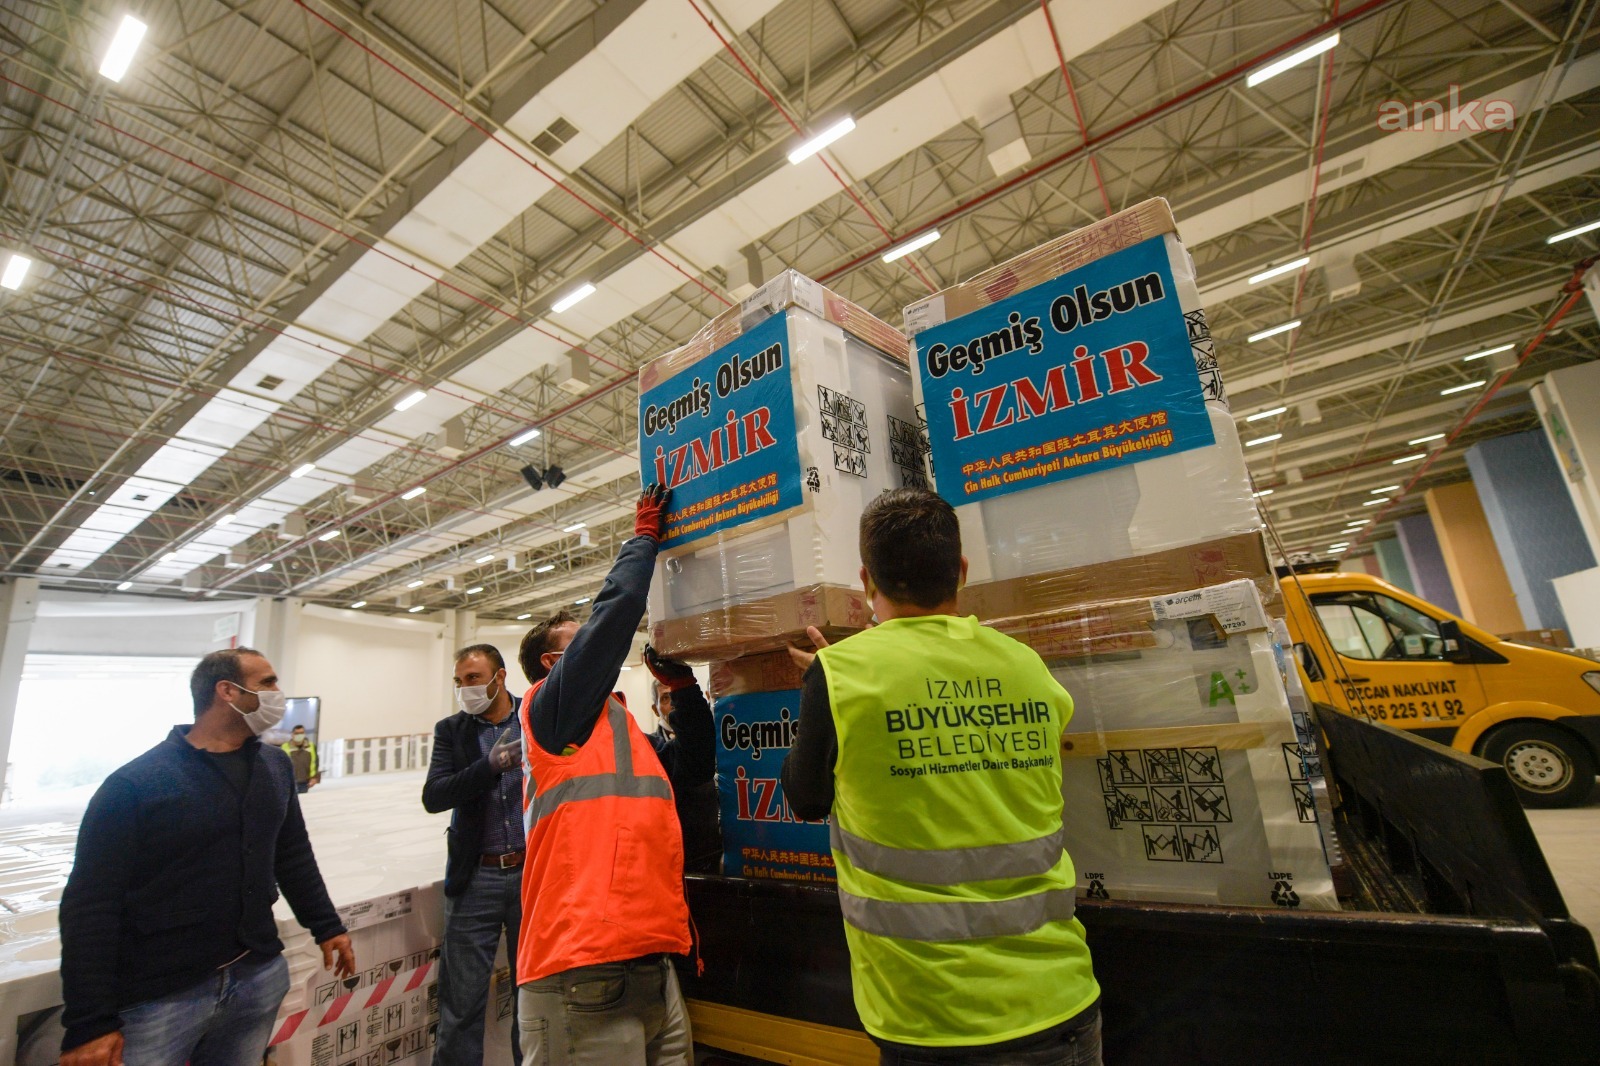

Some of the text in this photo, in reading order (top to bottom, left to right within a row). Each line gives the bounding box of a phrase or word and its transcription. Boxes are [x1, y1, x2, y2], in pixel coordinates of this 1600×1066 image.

[926, 271, 1165, 378] Geçmiş Olsun
[644, 342, 782, 437] Geçmiş Olsun
[948, 340, 1163, 441] İZMİR
[654, 406, 777, 492] İZMİR
[964, 430, 1174, 495] Çin Halk Cumhuriyeti Ankara Büyükelçiliği
[681, 513, 714, 535] Cumhuriyeti
[715, 506, 737, 523] Ankara
[737, 489, 779, 514] Büyükelçiliği
[926, 676, 1003, 700] İZMİR
[885, 698, 1051, 733] BÜYÜKŞEHİR
[1390, 702, 1418, 719] 225
[1421, 701, 1440, 717] 31
[1444, 699, 1466, 716] 92
[898, 727, 1048, 760] BELEDİYESİ
[889, 764, 927, 778] Sosyal
[741, 847, 836, 868] 中华人民共和国驻土
[1084, 872, 1104, 881] LDPE
[1267, 871, 1294, 881] LDPE
